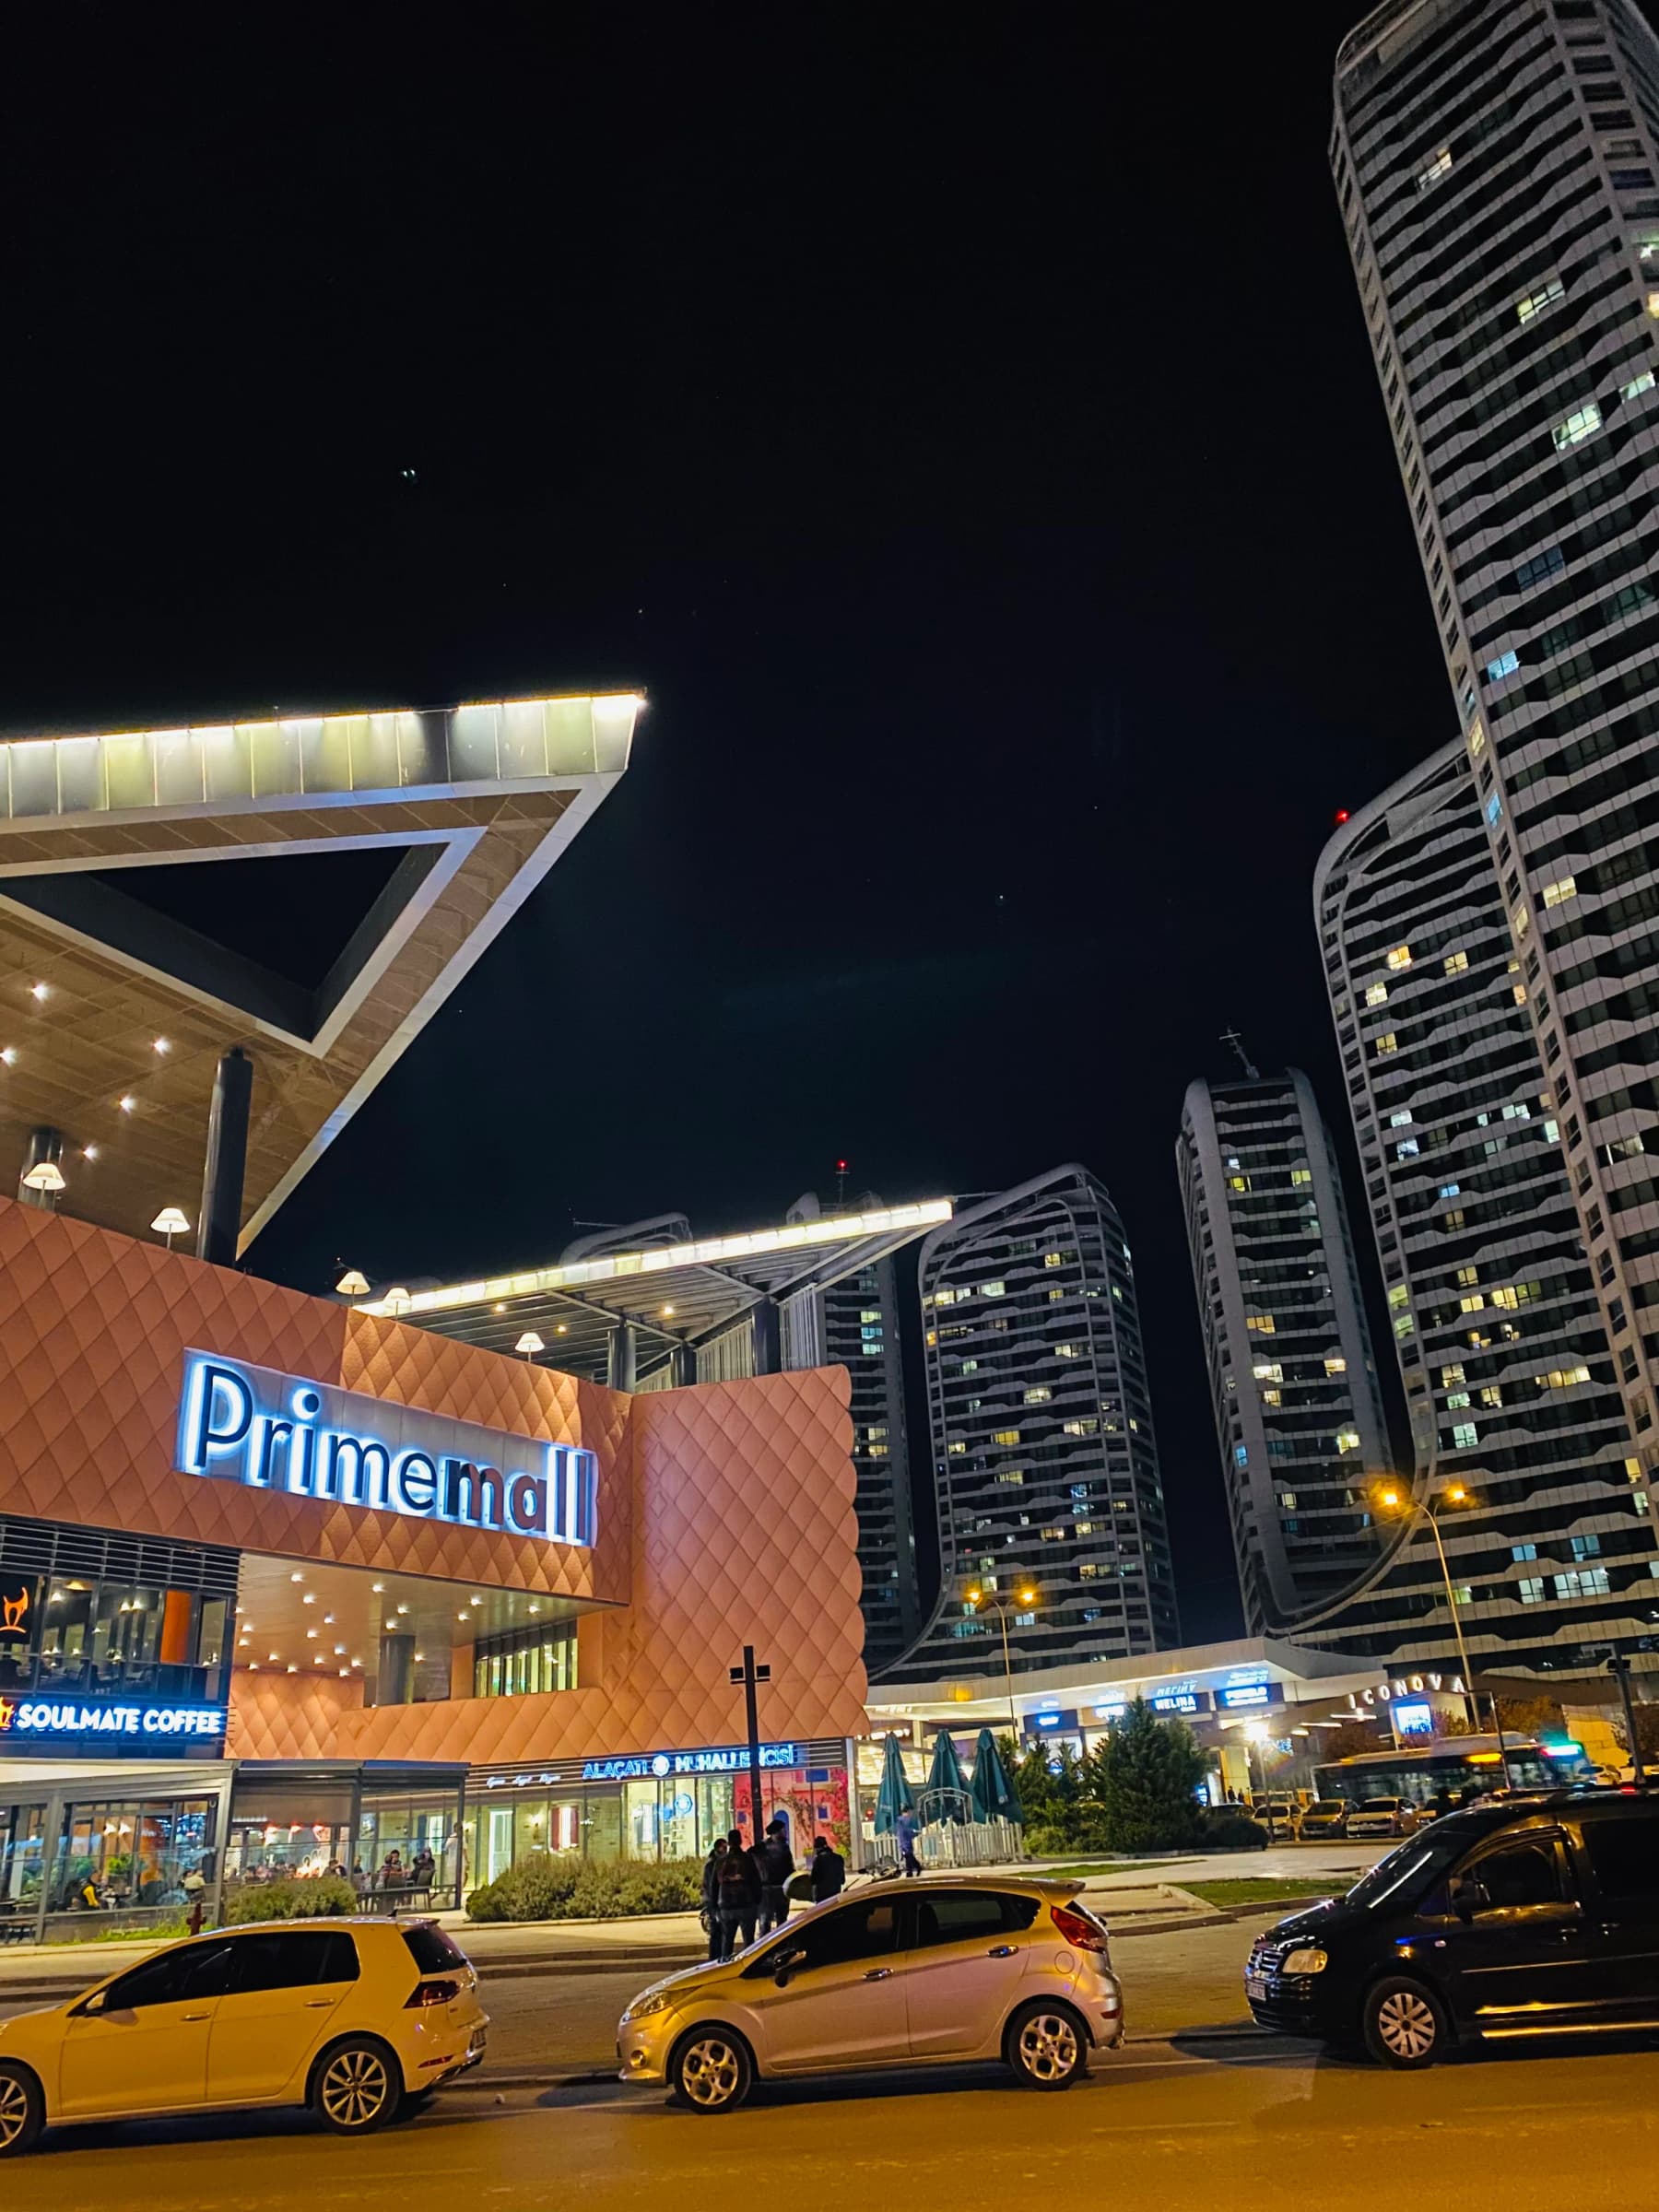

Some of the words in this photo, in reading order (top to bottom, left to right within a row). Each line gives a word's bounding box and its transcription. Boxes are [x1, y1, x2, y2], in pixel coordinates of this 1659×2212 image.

[190, 1362, 589, 1542] Primemall
[1348, 1673, 1466, 1710] ICONOVA
[17, 1703, 140, 1733] SOULMATE
[143, 1709, 221, 1734] COFFEE
[582, 1759, 647, 1781] ALAÇATI
[675, 1744, 794, 1772] MUHALLEİCİSİ
